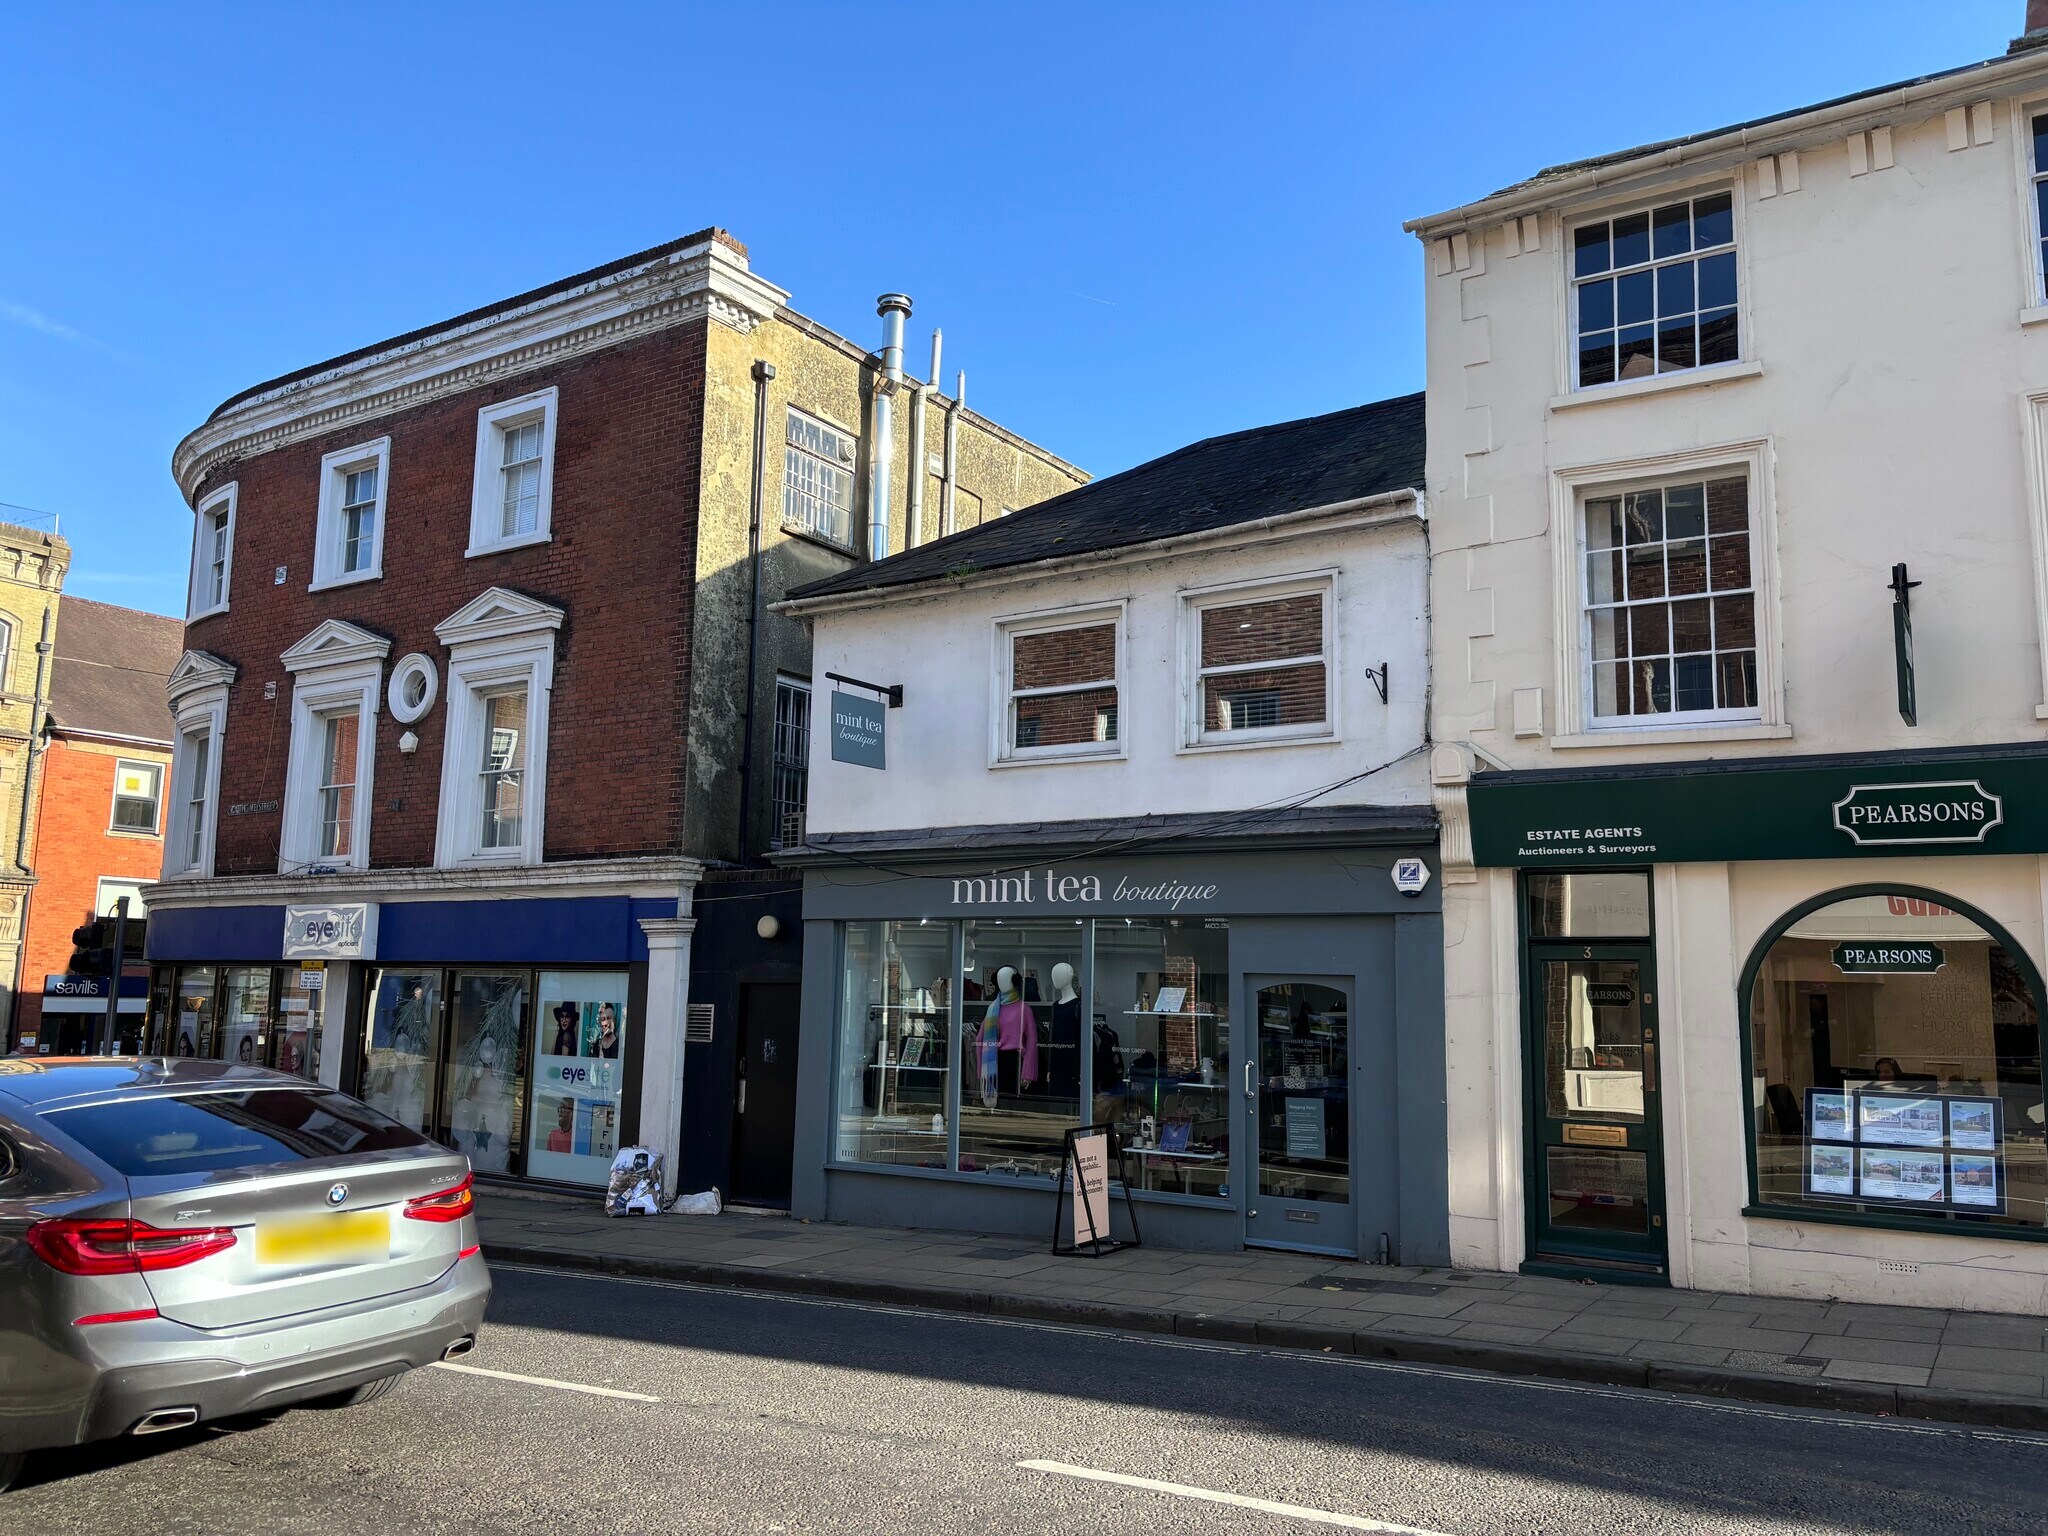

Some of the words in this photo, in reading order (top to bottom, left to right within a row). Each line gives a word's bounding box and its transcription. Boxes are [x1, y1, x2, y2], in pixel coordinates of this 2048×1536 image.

[835, 712, 863, 729] mint
[865, 717, 882, 733] tea
[839, 726, 878, 748] boutique
[1849, 801, 1985, 825] PEARSONS
[1526, 829, 1581, 840] ESTATE
[1584, 826, 1643, 839] AGENTS
[1517, 846, 1584, 856] Auctioneers
[1587, 845, 1596, 854] &
[1599, 844, 1657, 855] Surveyors
[950, 869, 1036, 904] mint
[1044, 869, 1103, 903] tea
[1112, 875, 1220, 911] boutique
[1583, 946, 1592, 959] 3
[1843, 949, 1933, 964] PEARSONS
[55, 980, 99, 995] savills
[1588, 990, 1632, 1000] EARSONS
[1922, 1021, 1990, 1034] HURSLEY
